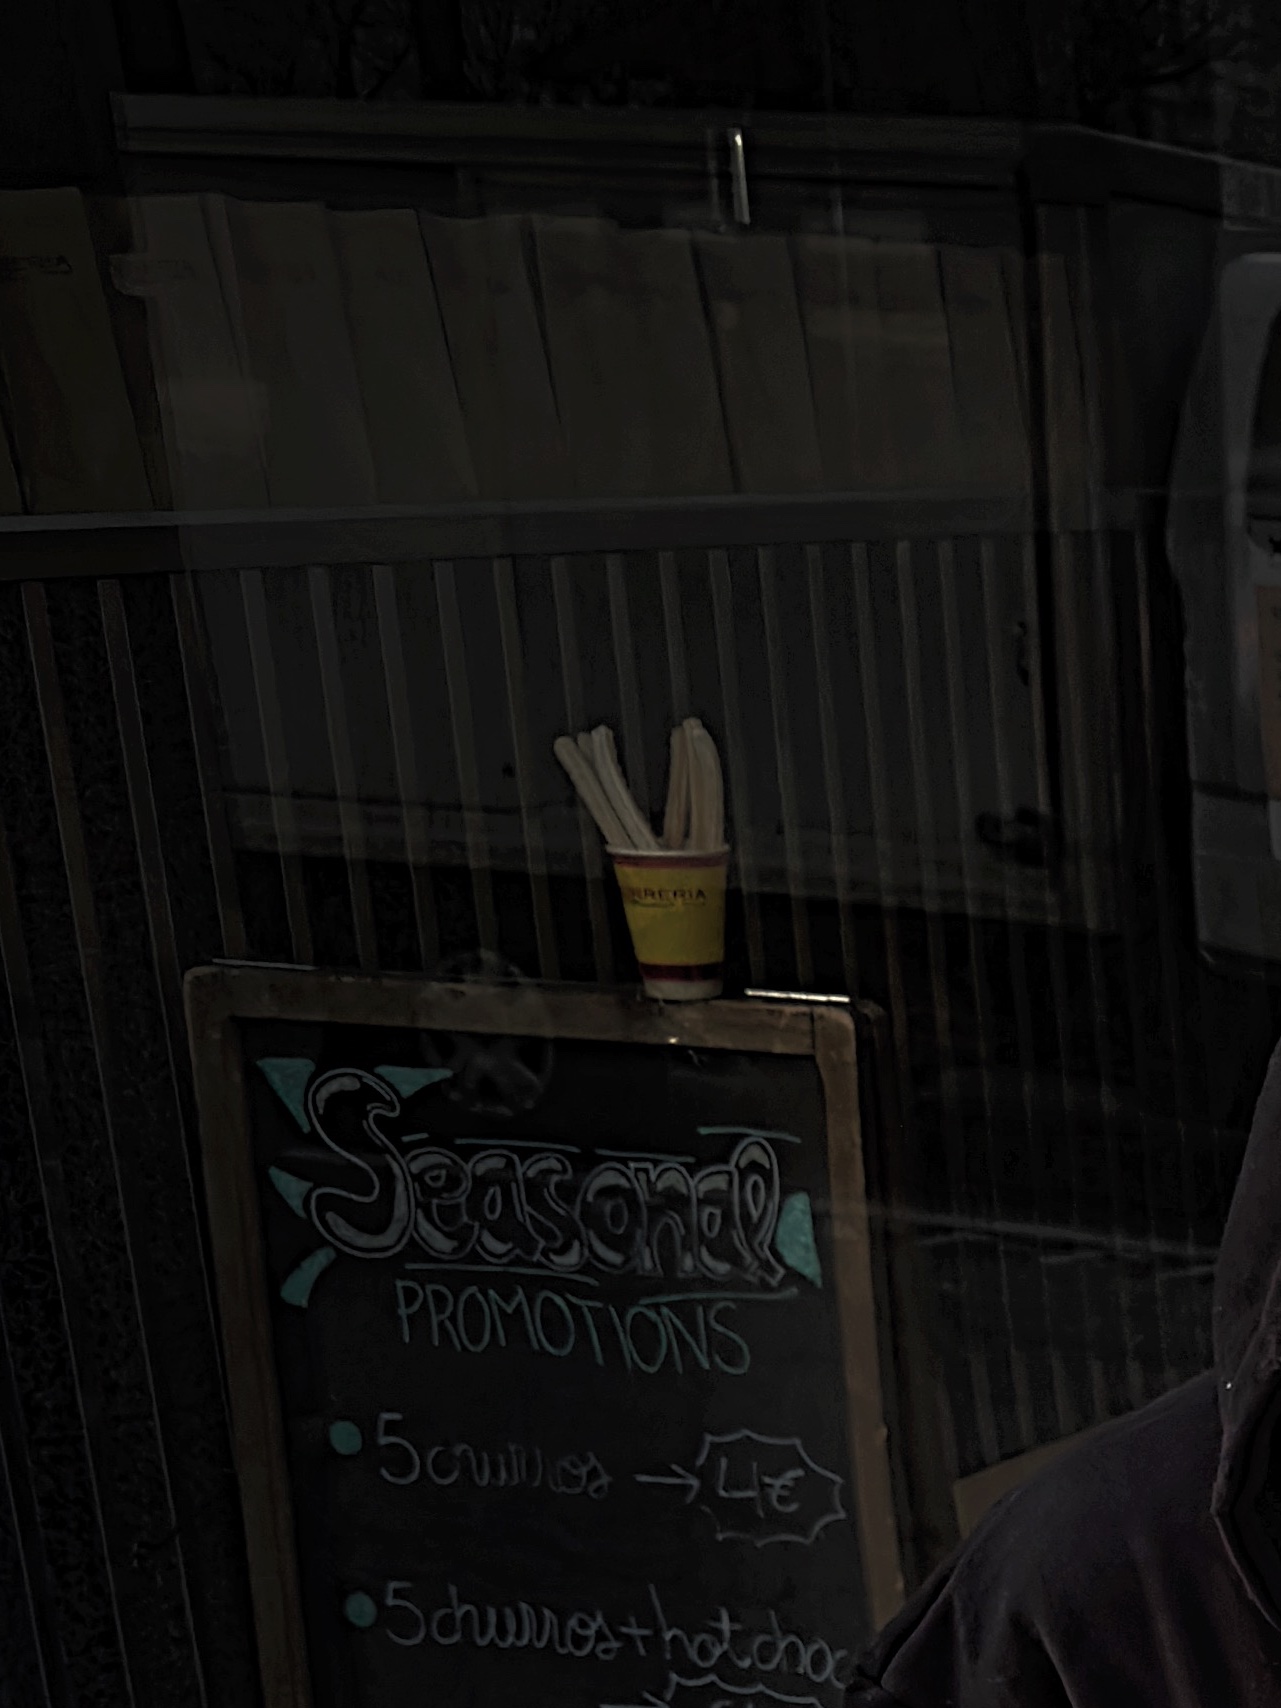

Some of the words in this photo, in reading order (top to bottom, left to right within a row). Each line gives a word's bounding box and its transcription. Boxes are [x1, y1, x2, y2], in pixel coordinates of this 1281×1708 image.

[306, 1067, 786, 1287] Seasonal
[394, 1278, 751, 1376] PROMOTIONS
[716, 1455, 806, 1518] 4€
